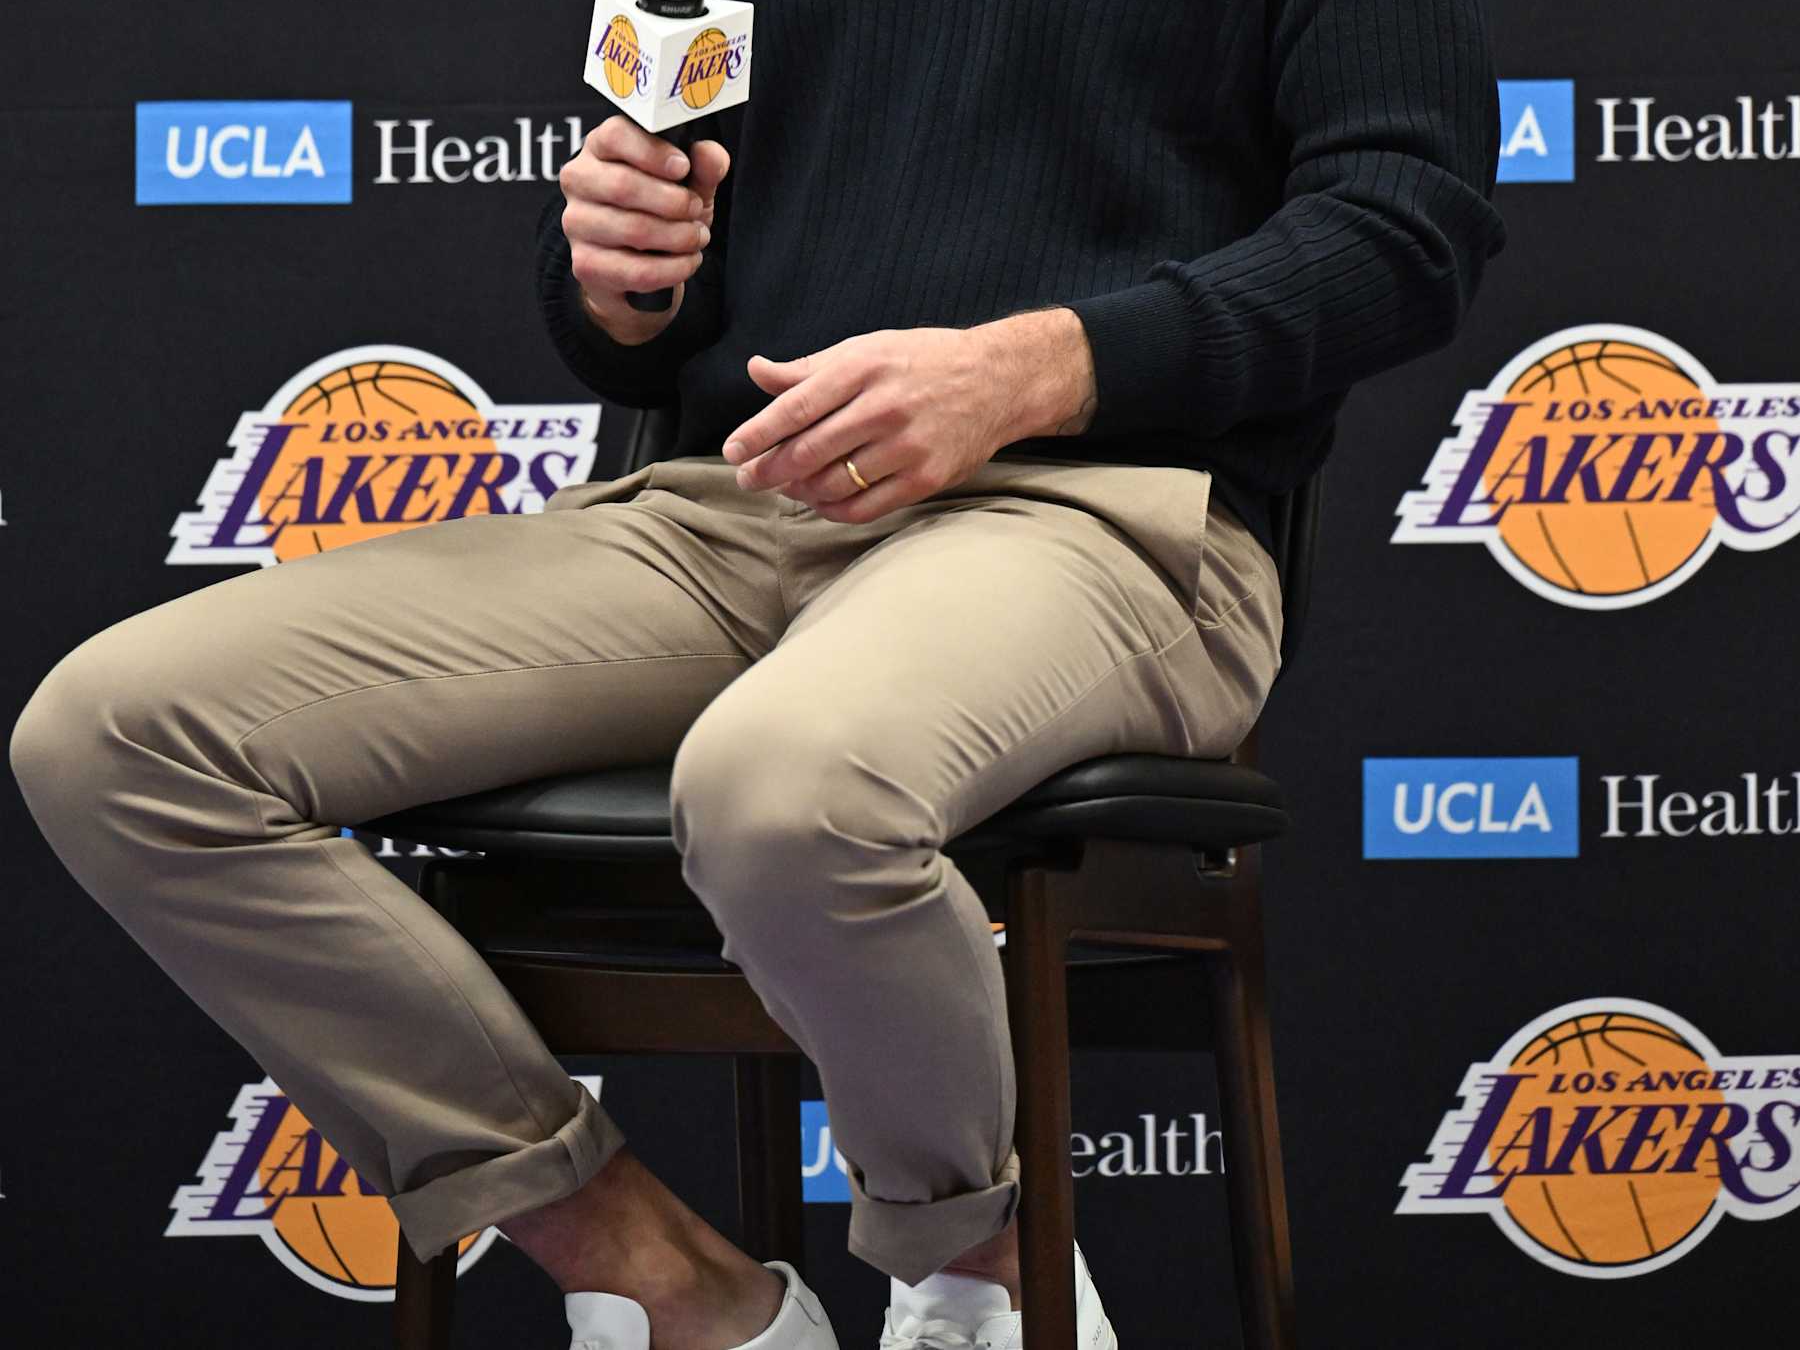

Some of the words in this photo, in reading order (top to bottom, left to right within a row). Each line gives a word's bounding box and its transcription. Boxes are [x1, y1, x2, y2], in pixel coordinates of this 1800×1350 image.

[595, 24, 651, 97] LAKERS
[669, 45, 747, 98] LAKERS
[165, 124, 326, 180] UCLA
[321, 420, 390, 442] LOS
[399, 417, 582, 440] ANGELES
[1543, 399, 1616, 422] LOS
[1620, 397, 1800, 420] ANGELES
[1424, 402, 1800, 534] LAKERS
[1393, 781, 1552, 834] UCLA
[1602, 771, 1800, 837] Healt
[1547, 1070, 1620, 1093] LOS
[1070, 1113, 1226, 1177] ealth
[1417, 1073, 1800, 1205] LAKERS
